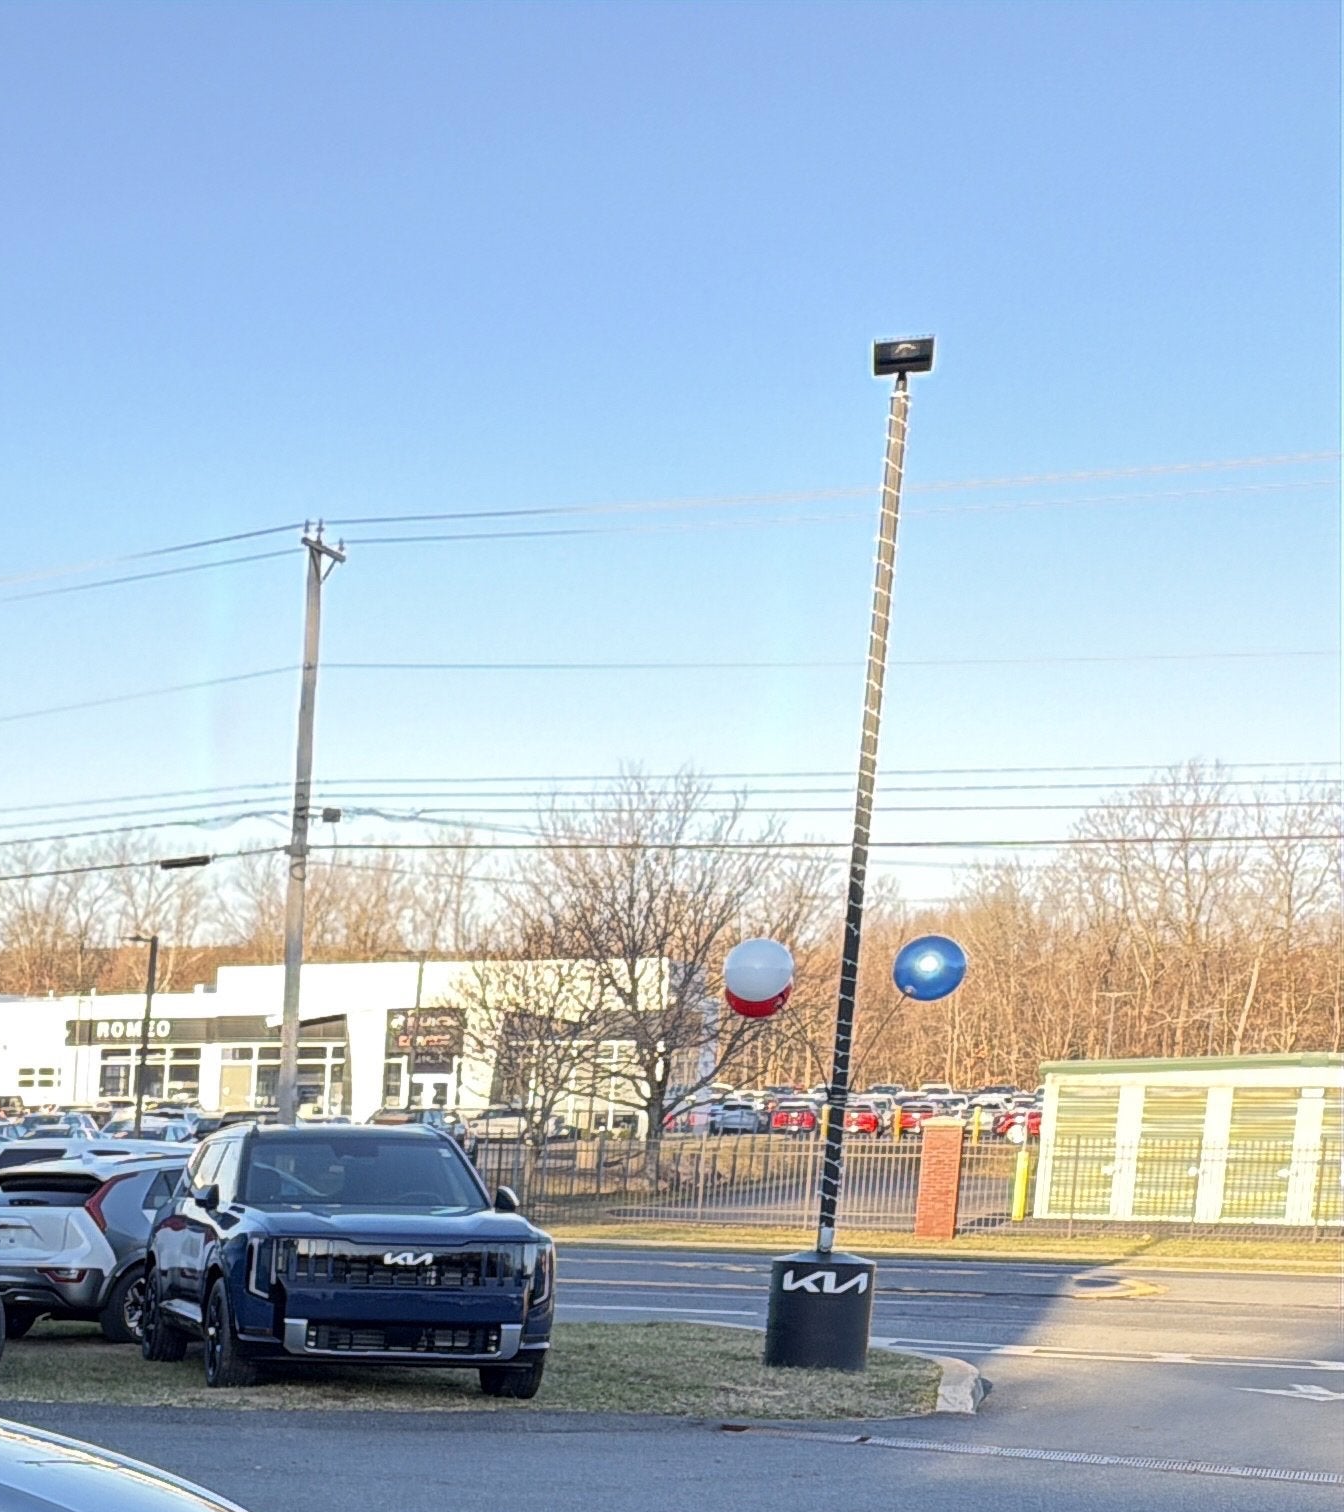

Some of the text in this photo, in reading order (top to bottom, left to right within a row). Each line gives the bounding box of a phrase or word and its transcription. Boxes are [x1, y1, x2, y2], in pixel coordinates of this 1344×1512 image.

[96, 1020, 171, 1038] ROMEO
[384, 1252, 433, 1266] KIA
[782, 1269, 868, 1295] KIA
